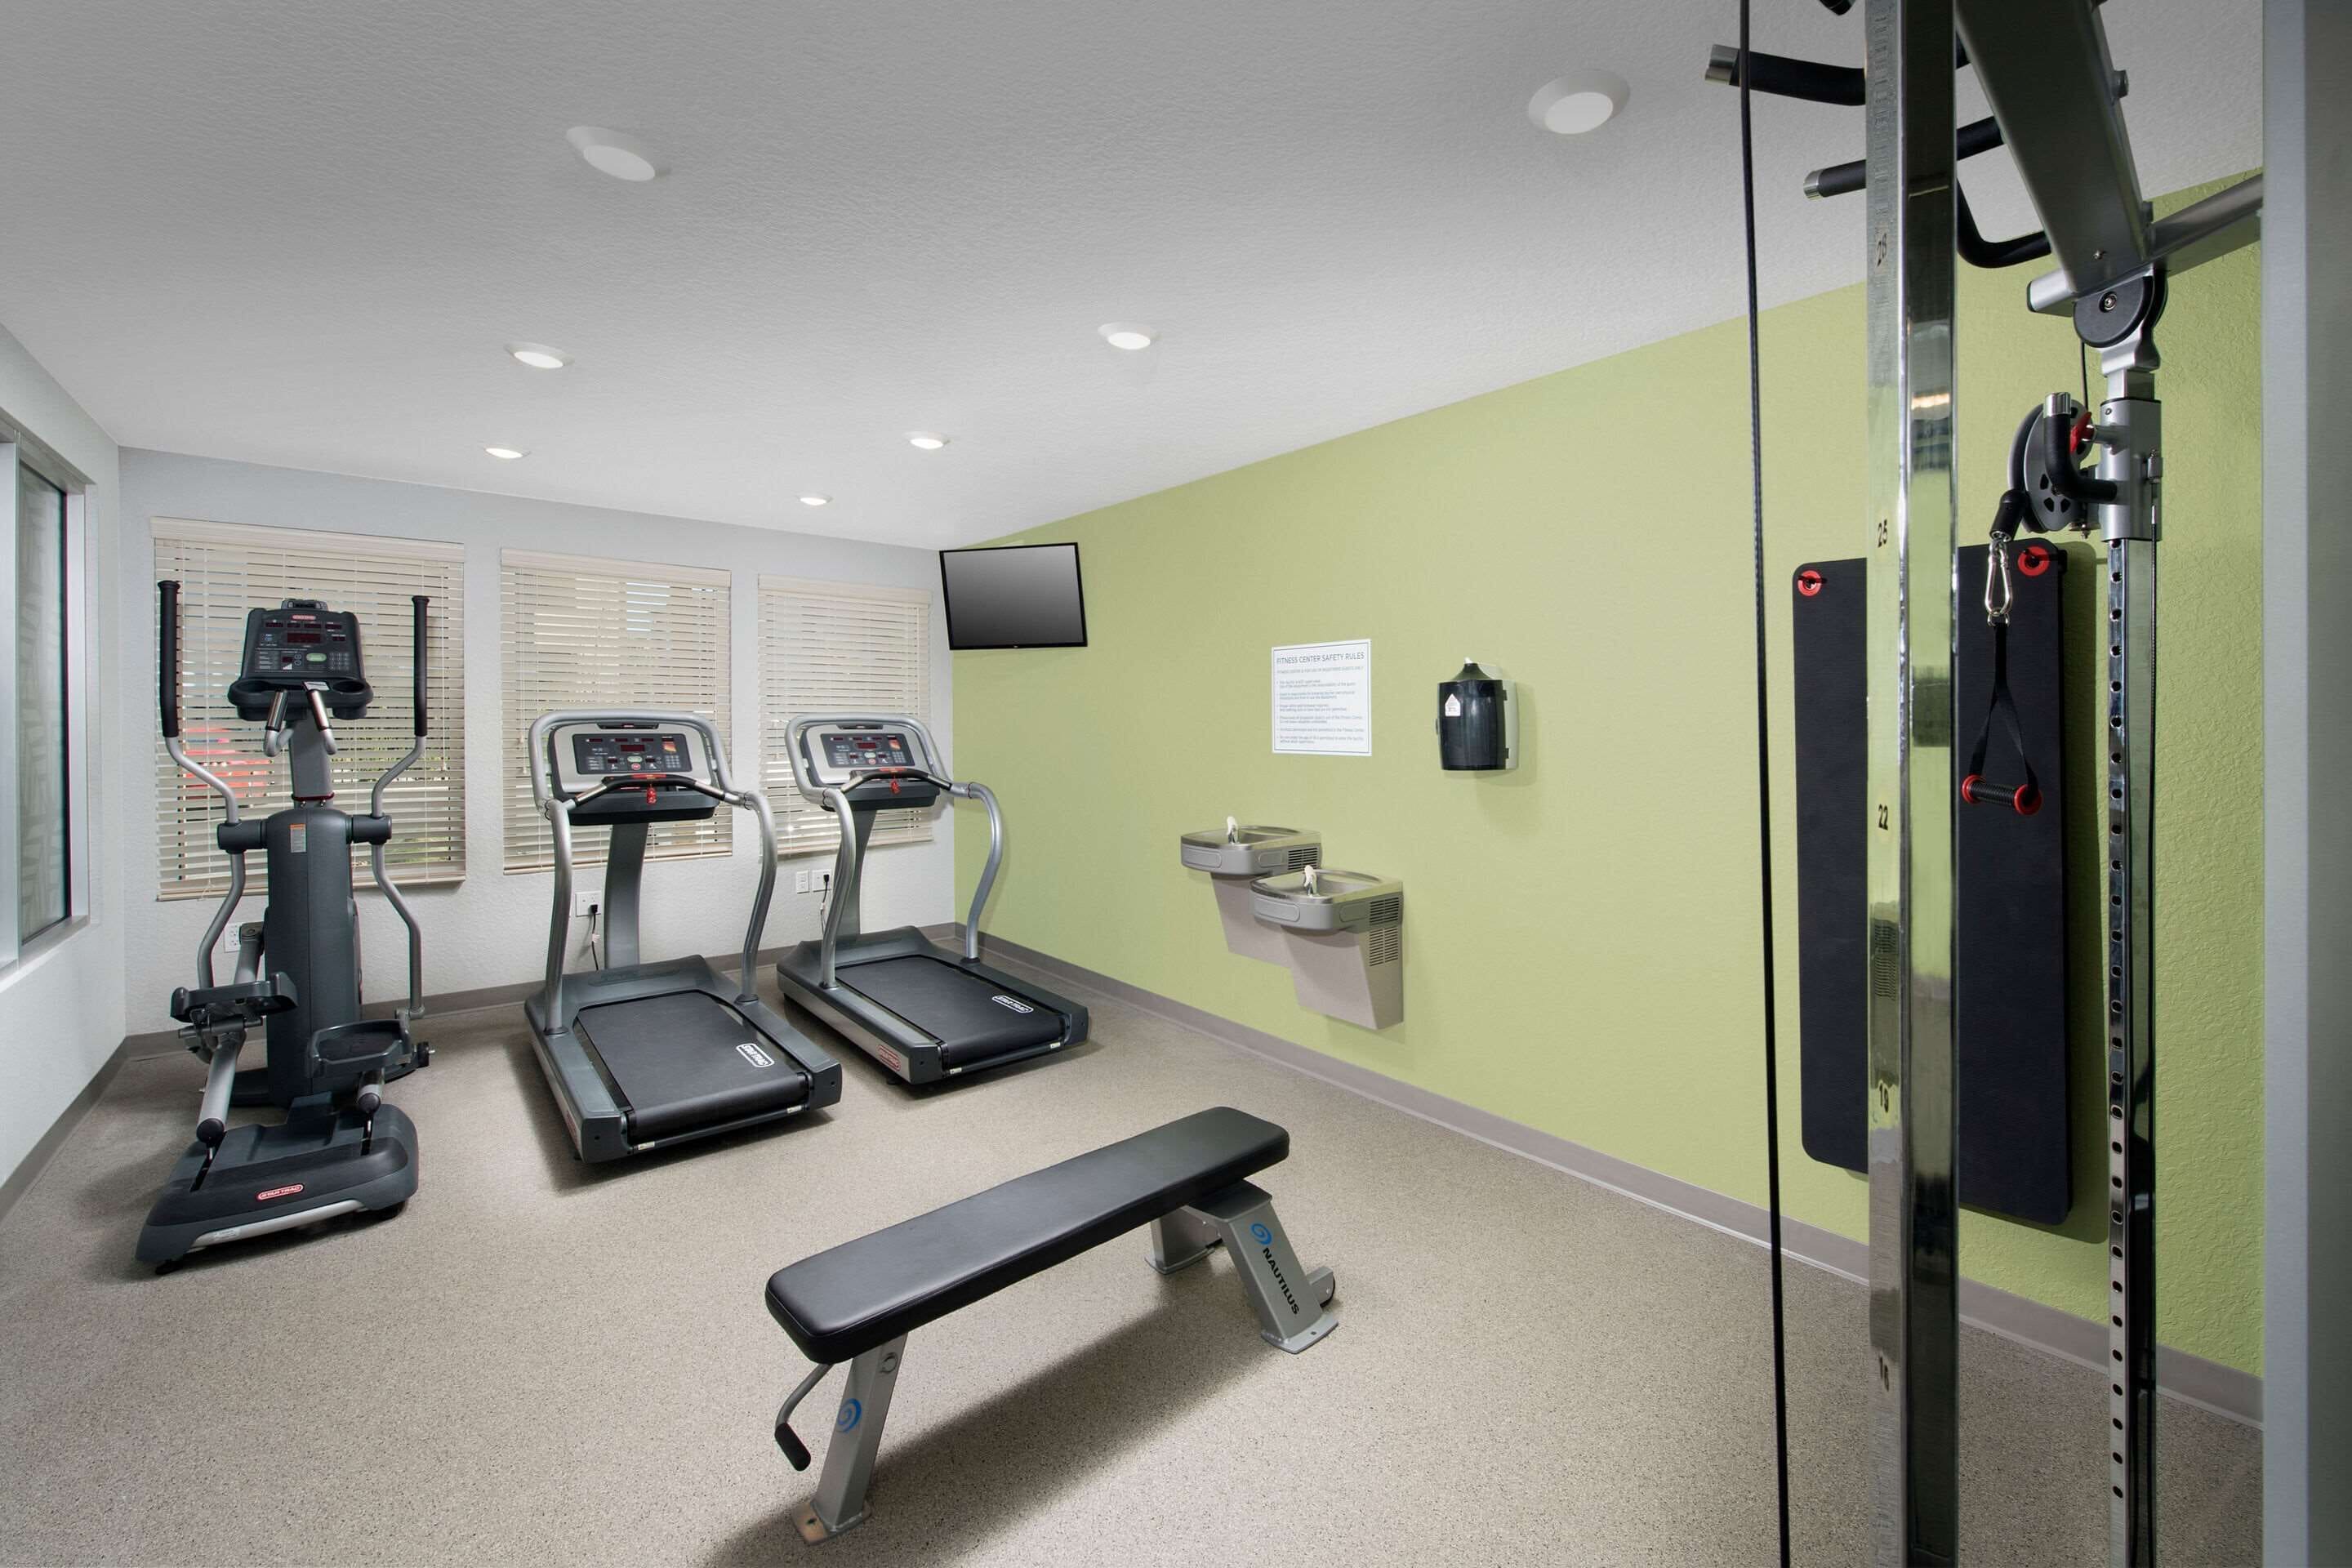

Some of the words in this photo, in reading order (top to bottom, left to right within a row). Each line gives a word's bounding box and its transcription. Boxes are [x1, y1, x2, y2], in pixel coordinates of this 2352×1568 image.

[1878, 519, 1888, 548] 25
[1276, 656, 1298, 665] FITNESS
[1298, 655, 1321, 663] CENTER
[1322, 653, 1343, 662] SAFETY
[1345, 652, 1365, 660] RULES
[1878, 804, 1888, 831] 22
[1879, 1083, 1889, 1113] 19
[1263, 1247, 1299, 1315] NAUTILUS
